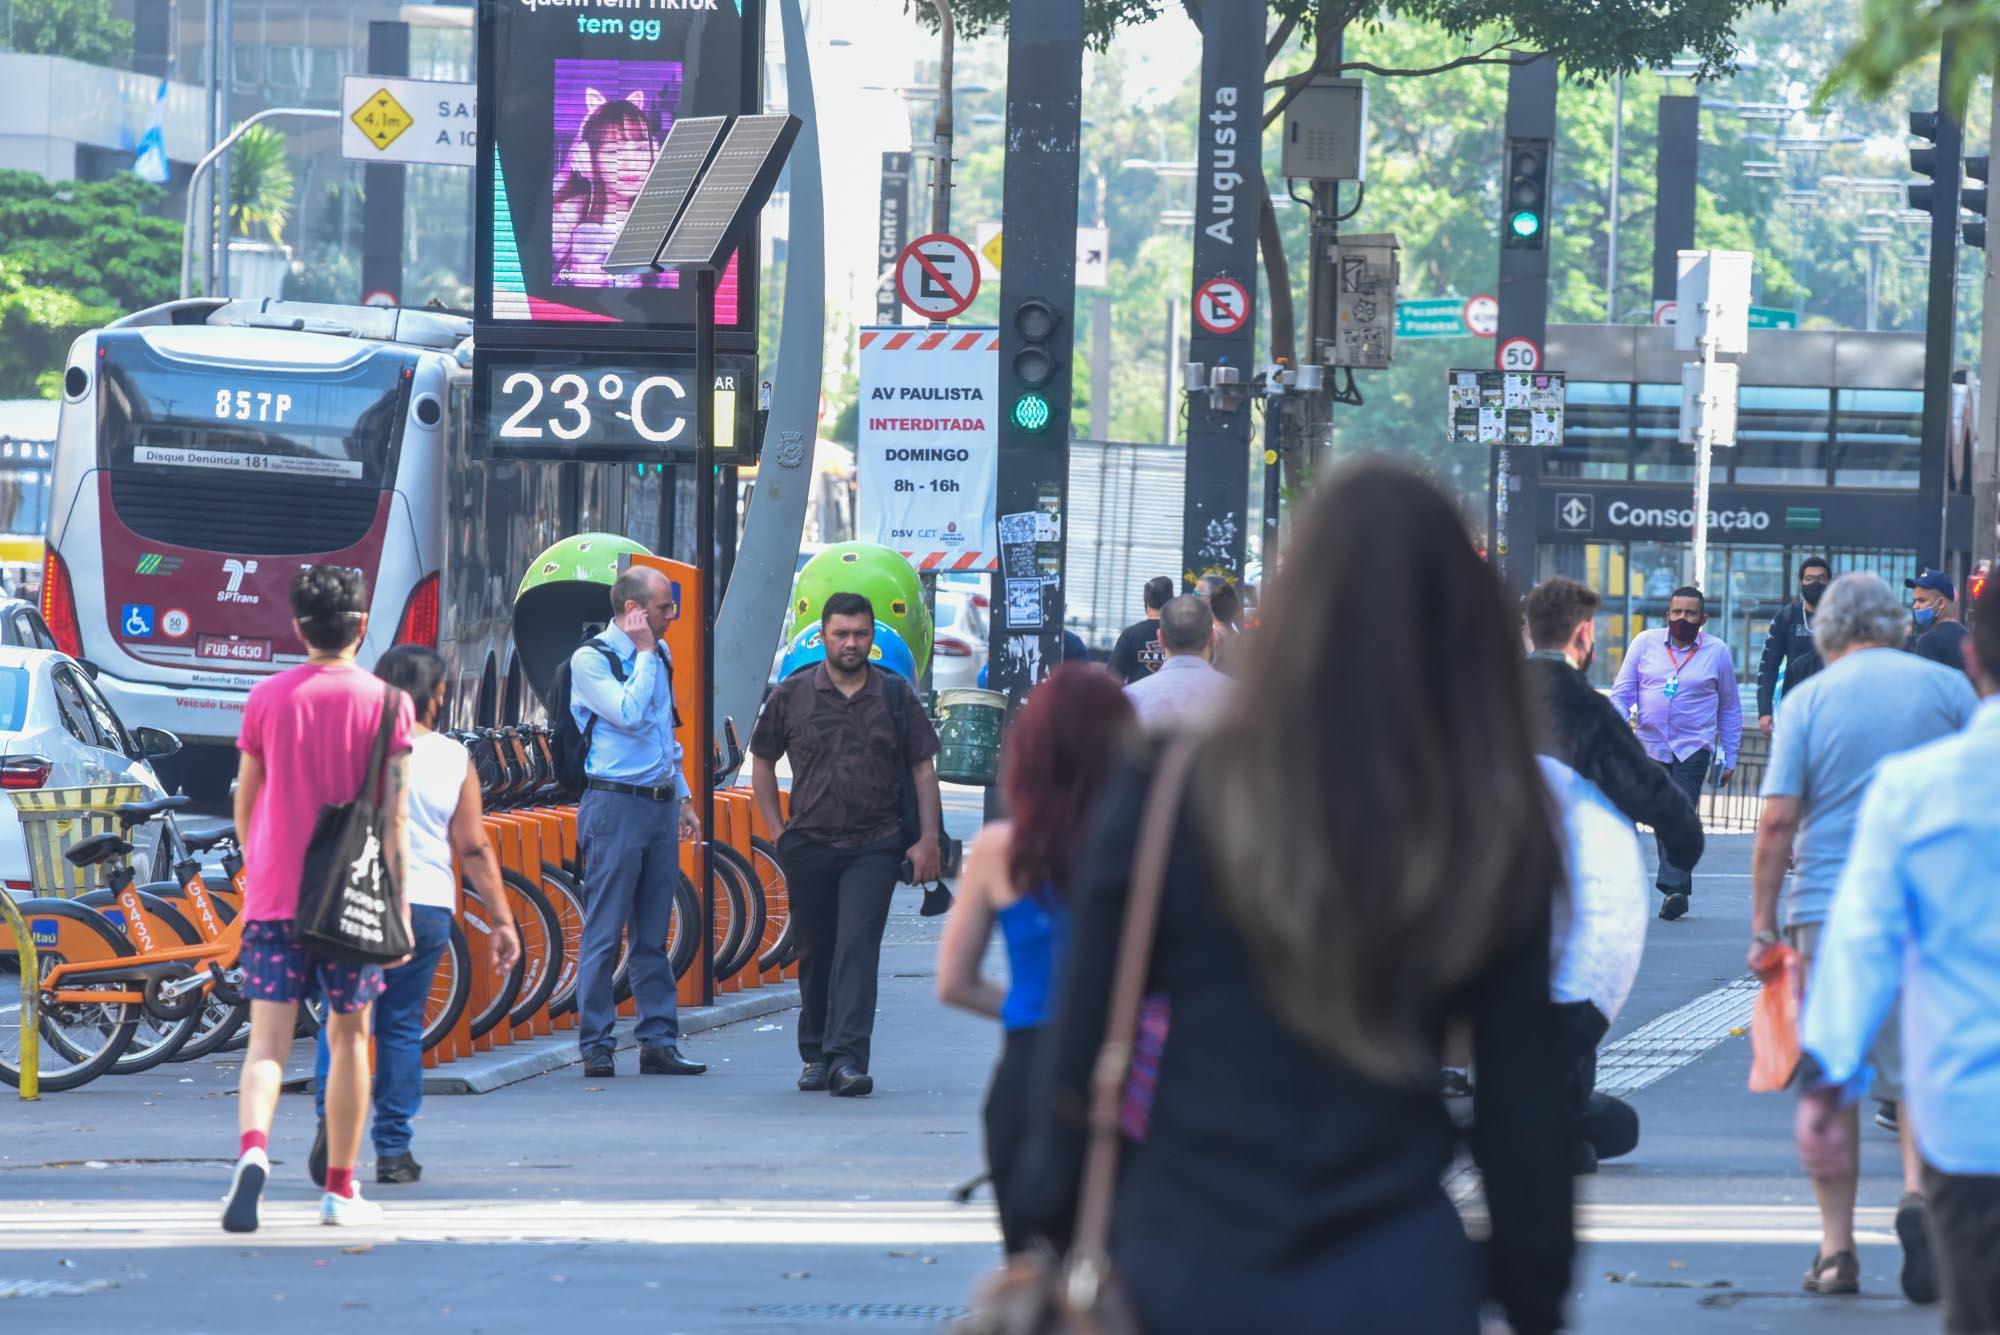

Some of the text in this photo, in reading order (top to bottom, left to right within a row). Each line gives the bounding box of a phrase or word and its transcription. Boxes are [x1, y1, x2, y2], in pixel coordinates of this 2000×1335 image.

[577, 14, 661, 41] tem gg
[436, 129, 451, 145] A
[1206, 86, 1242, 245] Augusta
[879, 199, 898, 258] Cintra
[1507, 348, 1534, 366] 50
[714, 376, 735, 390] AR
[872, 387, 984, 401] AV PAULISTA
[215, 389, 293, 423] 857P
[869, 418, 986, 431] INTERDITADA
[145, 449, 186, 464] Disque
[187, 453, 240, 467] Denúncia
[243, 456, 269, 469] 181
[885, 448, 969, 462] DOMINGO
[894, 479, 914, 492] 8h
[929, 479, 960, 492] 16h
[1607, 500, 1770, 533] Consoação
[891, 529, 913, 538] DSV
[217, 591, 259, 604] SPTrans
[176, 697, 216, 710] Veículo
[187, 881, 219, 936] G441
[121, 892, 154, 951] G432
[32, 931, 56, 943] Itaú
